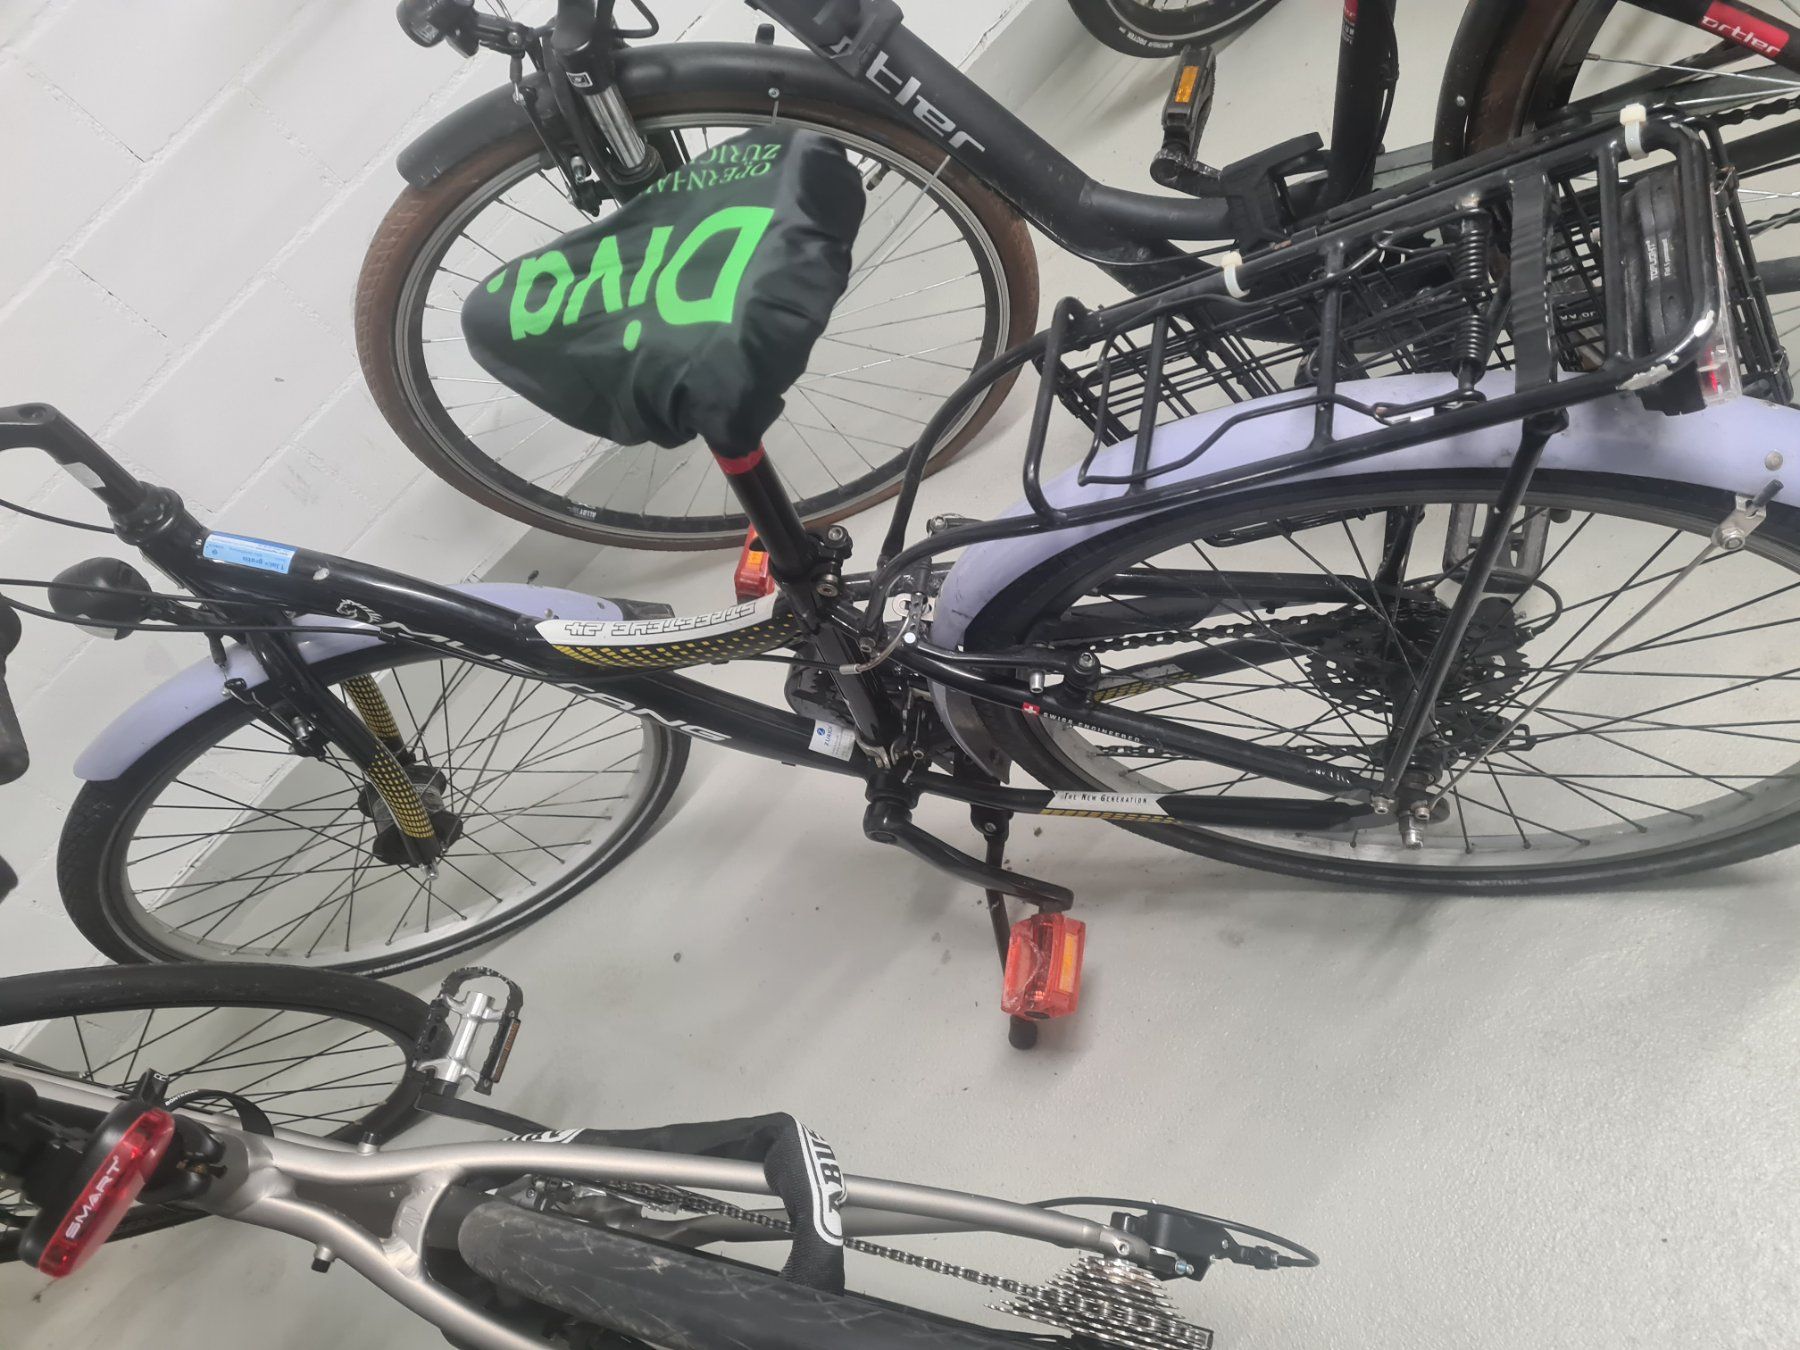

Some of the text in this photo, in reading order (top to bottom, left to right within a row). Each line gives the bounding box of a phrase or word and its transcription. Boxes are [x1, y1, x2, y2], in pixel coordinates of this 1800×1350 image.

[1701, 15, 1781, 54] ortler
[690, 143, 782, 166] ZÜRIC
[646, 162, 772, 194] OPERNHA
[564, 601, 758, 636] STREETEYE 24
[1043, 712, 1140, 743] SWISS ENGINEERED
[65, 1159, 121, 1241] SMART
